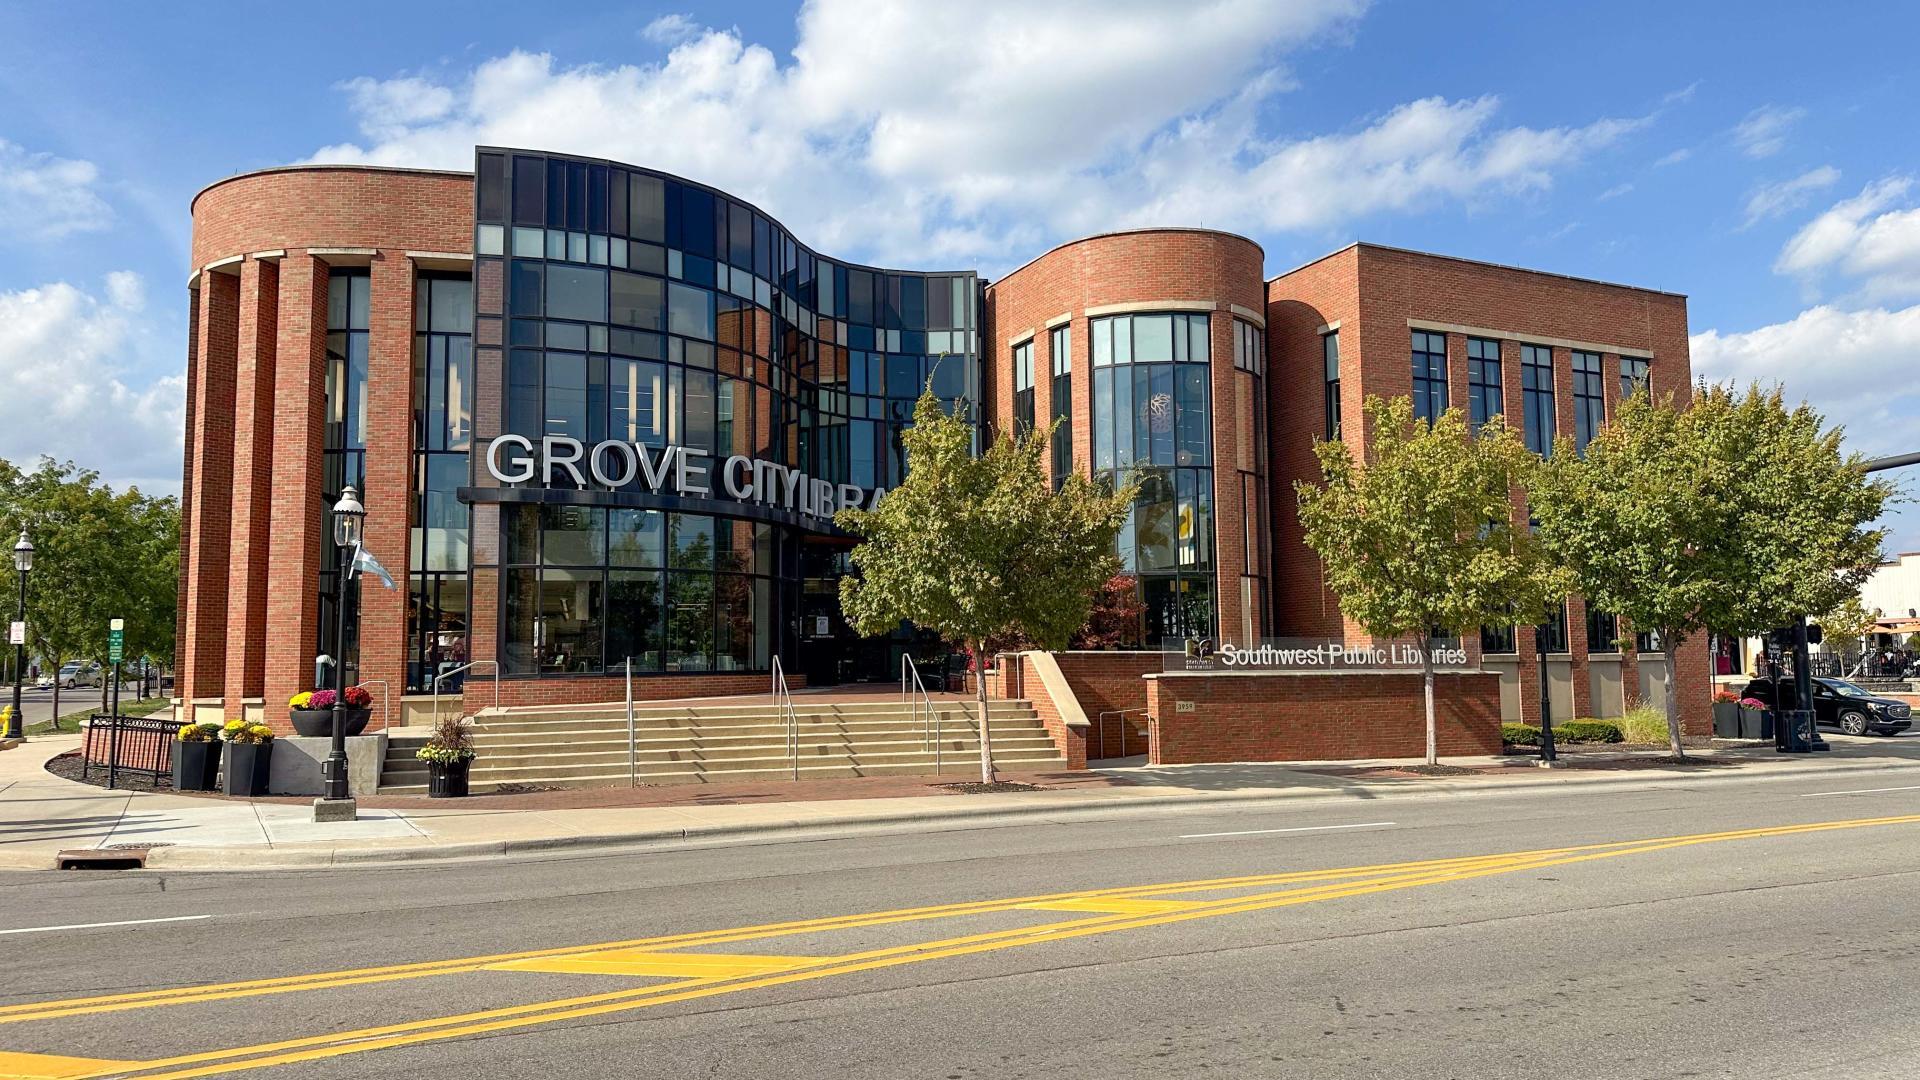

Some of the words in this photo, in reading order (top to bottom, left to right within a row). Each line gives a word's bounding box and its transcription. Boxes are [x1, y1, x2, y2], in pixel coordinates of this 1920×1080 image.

[486, 434, 710, 494] GROVE
[723, 455, 801, 509] CITY
[799, 473, 888, 519] LIBRA
[1221, 643, 1325, 666] Southwest
[1330, 643, 1387, 665] Public
[1391, 643, 1467, 665] Librries
